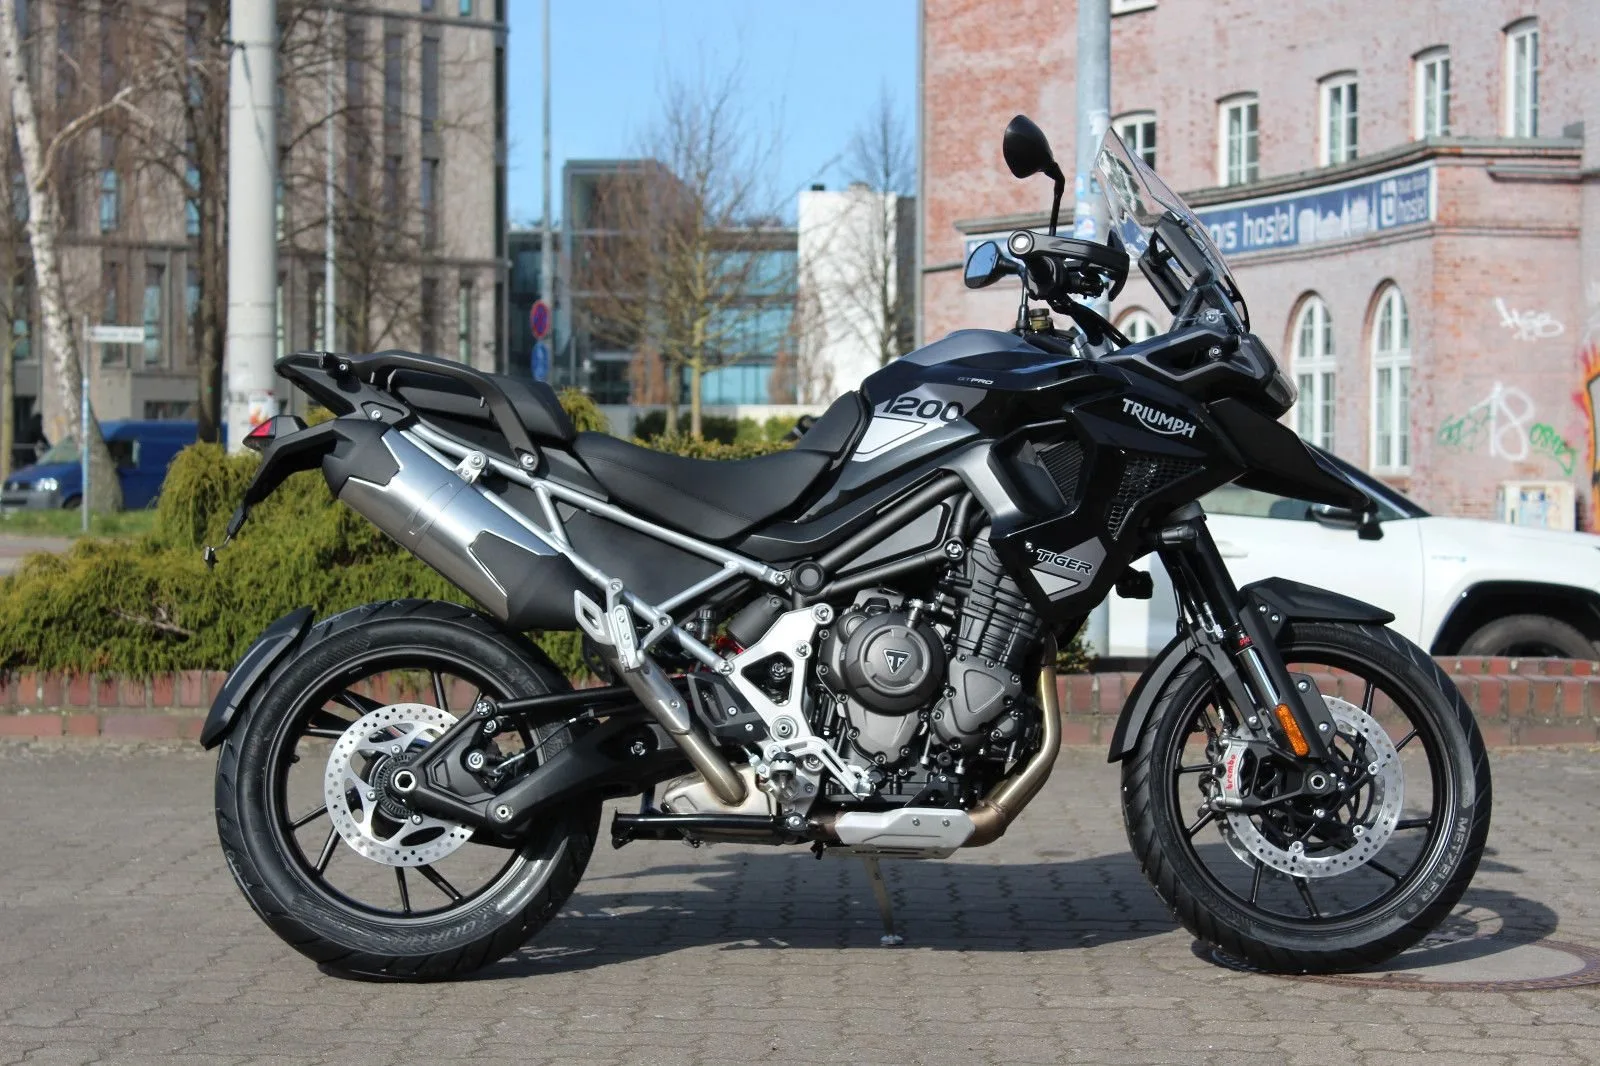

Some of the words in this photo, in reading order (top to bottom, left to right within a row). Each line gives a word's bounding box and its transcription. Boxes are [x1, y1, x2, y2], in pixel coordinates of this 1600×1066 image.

[1242, 203, 1296, 247] hostel
[883, 396, 964, 423] 1200
[1122, 398, 1197, 438] TRIUMPH
[1036, 548, 1093, 575] TIGER
[1418, 817, 1469, 902] METZELER
